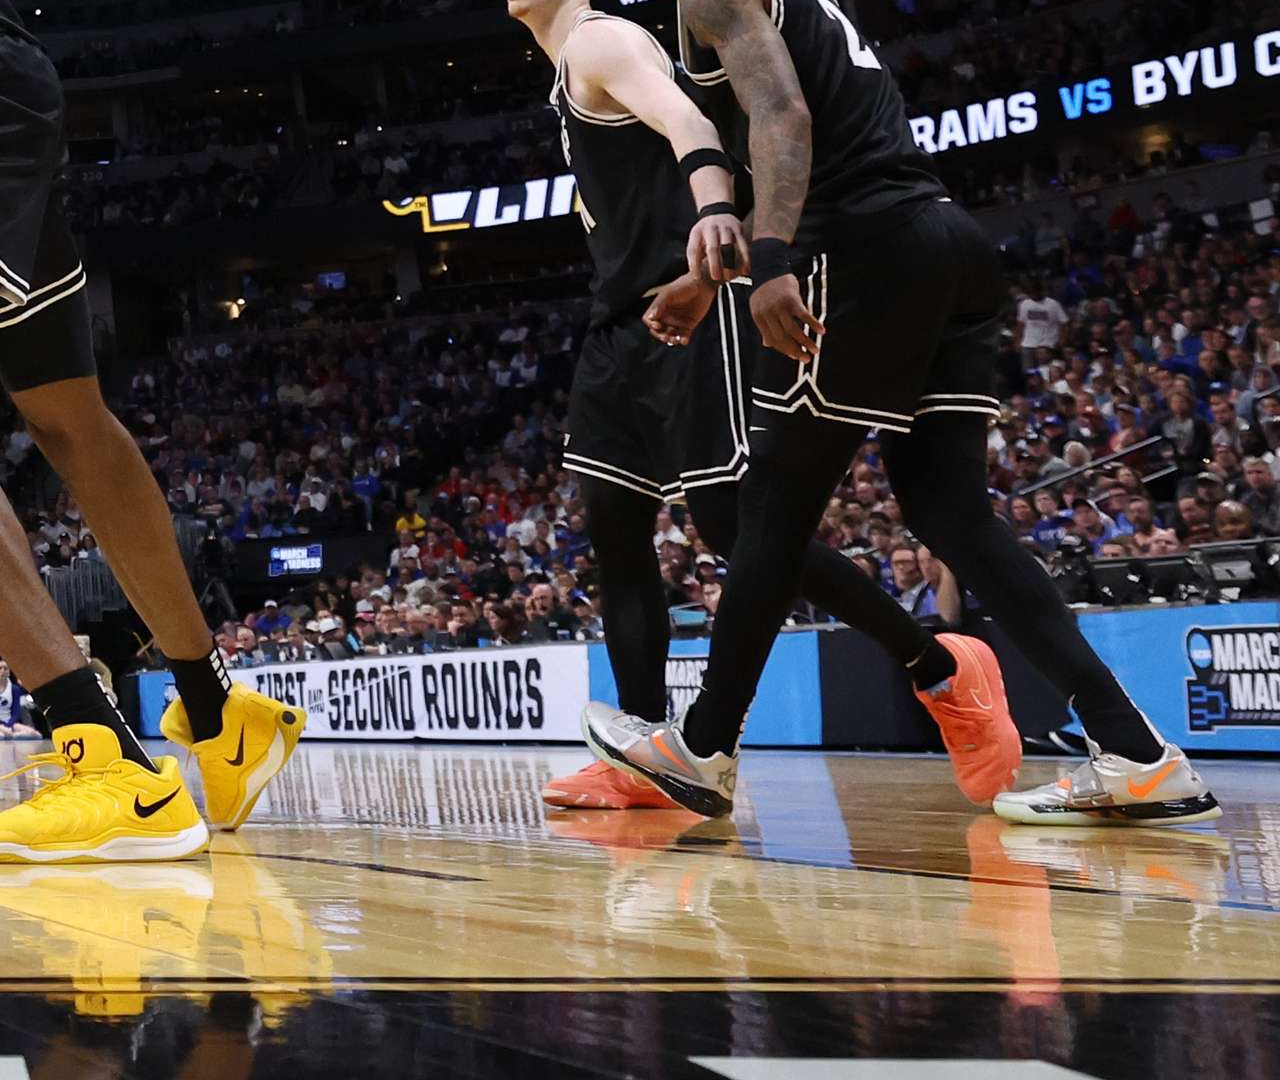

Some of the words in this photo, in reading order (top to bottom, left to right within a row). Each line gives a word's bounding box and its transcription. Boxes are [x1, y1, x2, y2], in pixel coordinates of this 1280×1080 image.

[908, 91, 1039, 155] RAMS
[1058, 78, 1114, 121] VS
[1131, 41, 1239, 108] BYU
[1210, 630, 1280, 671] MARC
[327, 666, 417, 732] SECOND
[420, 657, 544, 731] ROUNDS
